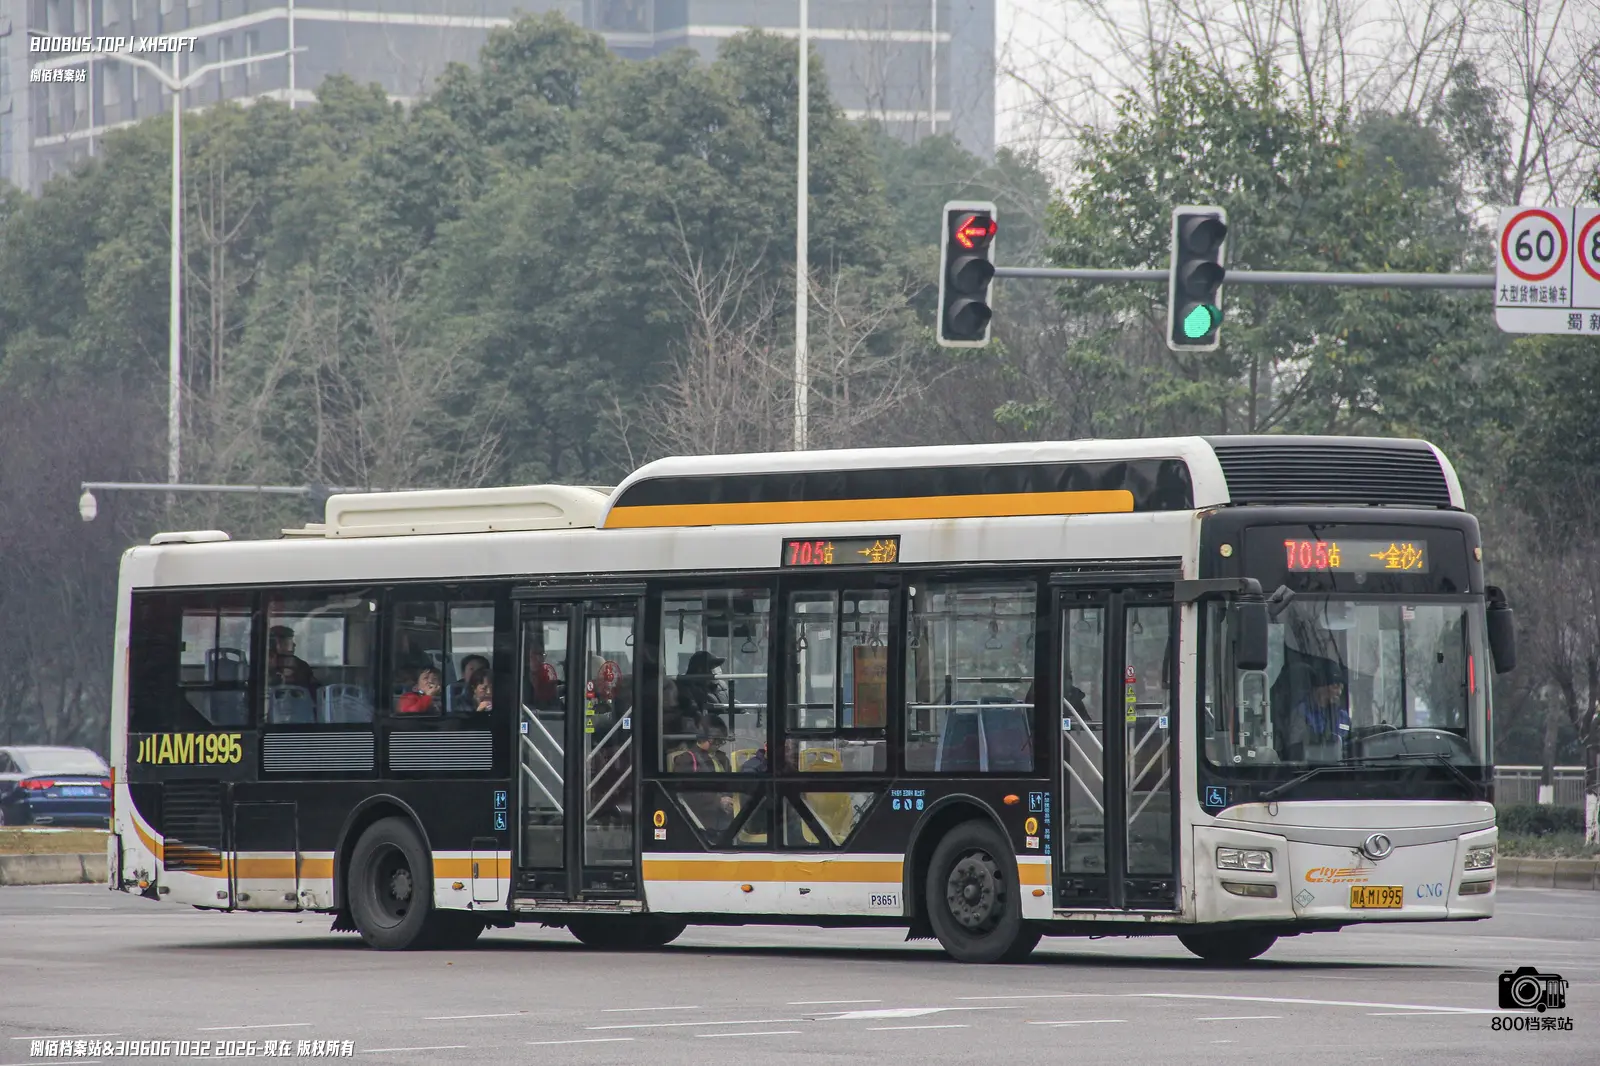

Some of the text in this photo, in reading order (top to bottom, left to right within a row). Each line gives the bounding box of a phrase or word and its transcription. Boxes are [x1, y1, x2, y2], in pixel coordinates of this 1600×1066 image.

[1515, 229, 1555, 262] 60
[1500, 284, 1568, 304] 大型货物运输车
[788, 541, 825, 565] 705
[1284, 540, 1328, 569] 705
[137, 733, 242, 764] 川AM1995
[871, 895, 897, 906] P3651
[1416, 883, 1443, 899] CNG
